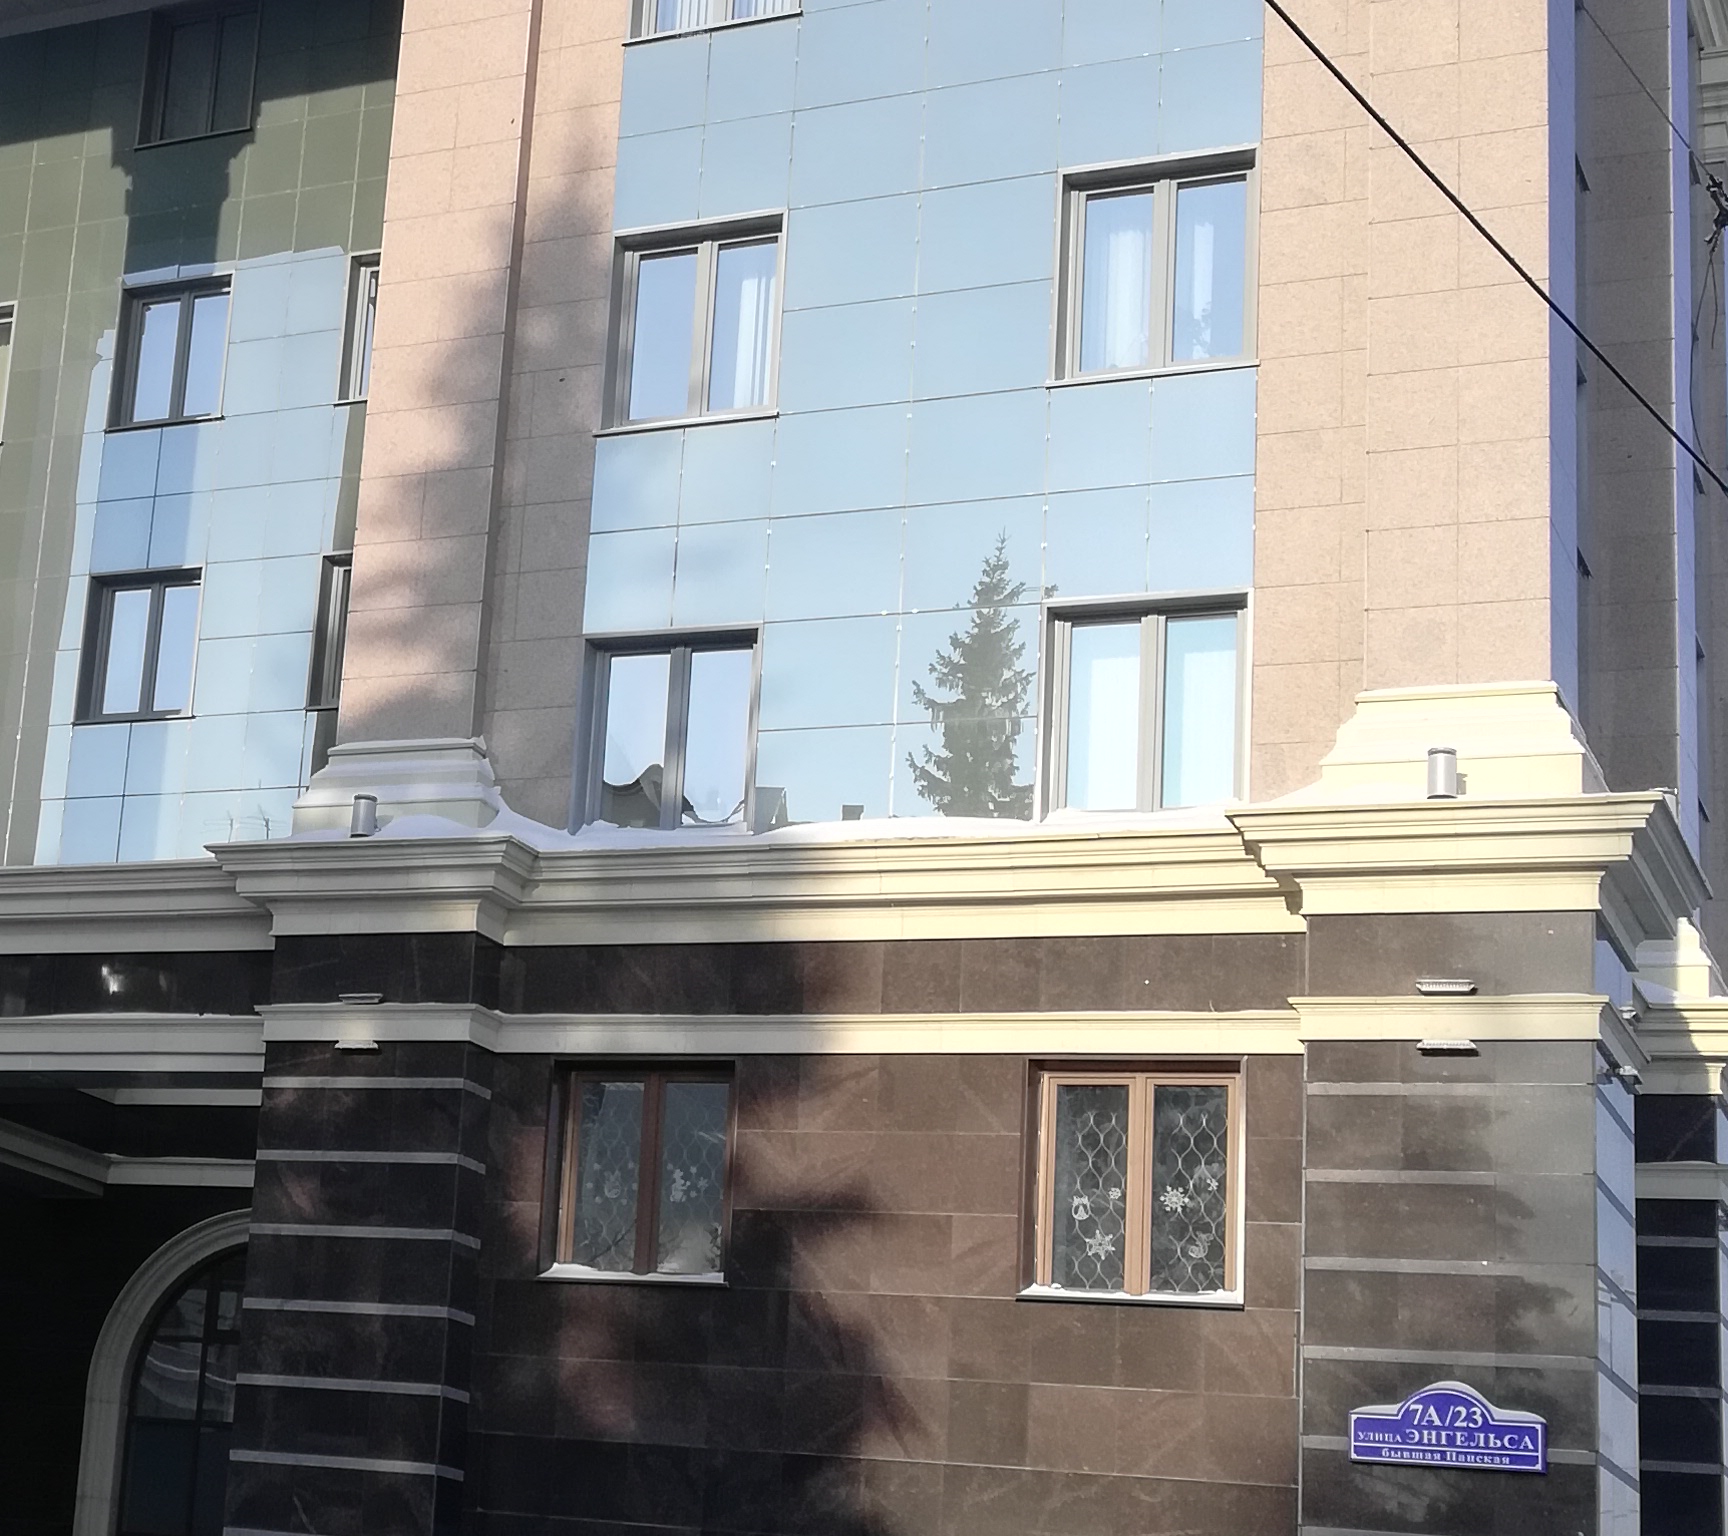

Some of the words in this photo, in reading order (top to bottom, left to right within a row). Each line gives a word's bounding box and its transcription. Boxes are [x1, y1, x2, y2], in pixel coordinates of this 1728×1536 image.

[1410, 1405, 1483, 1428] 7А/23
[1358, 1432, 1402, 1443] УЛИЦА
[1406, 1429, 1534, 1450] ЭНГЕЛЬСА
[1382, 1449, 1441, 1461] бывшая
[1447, 1452, 1510, 1465] Панская
